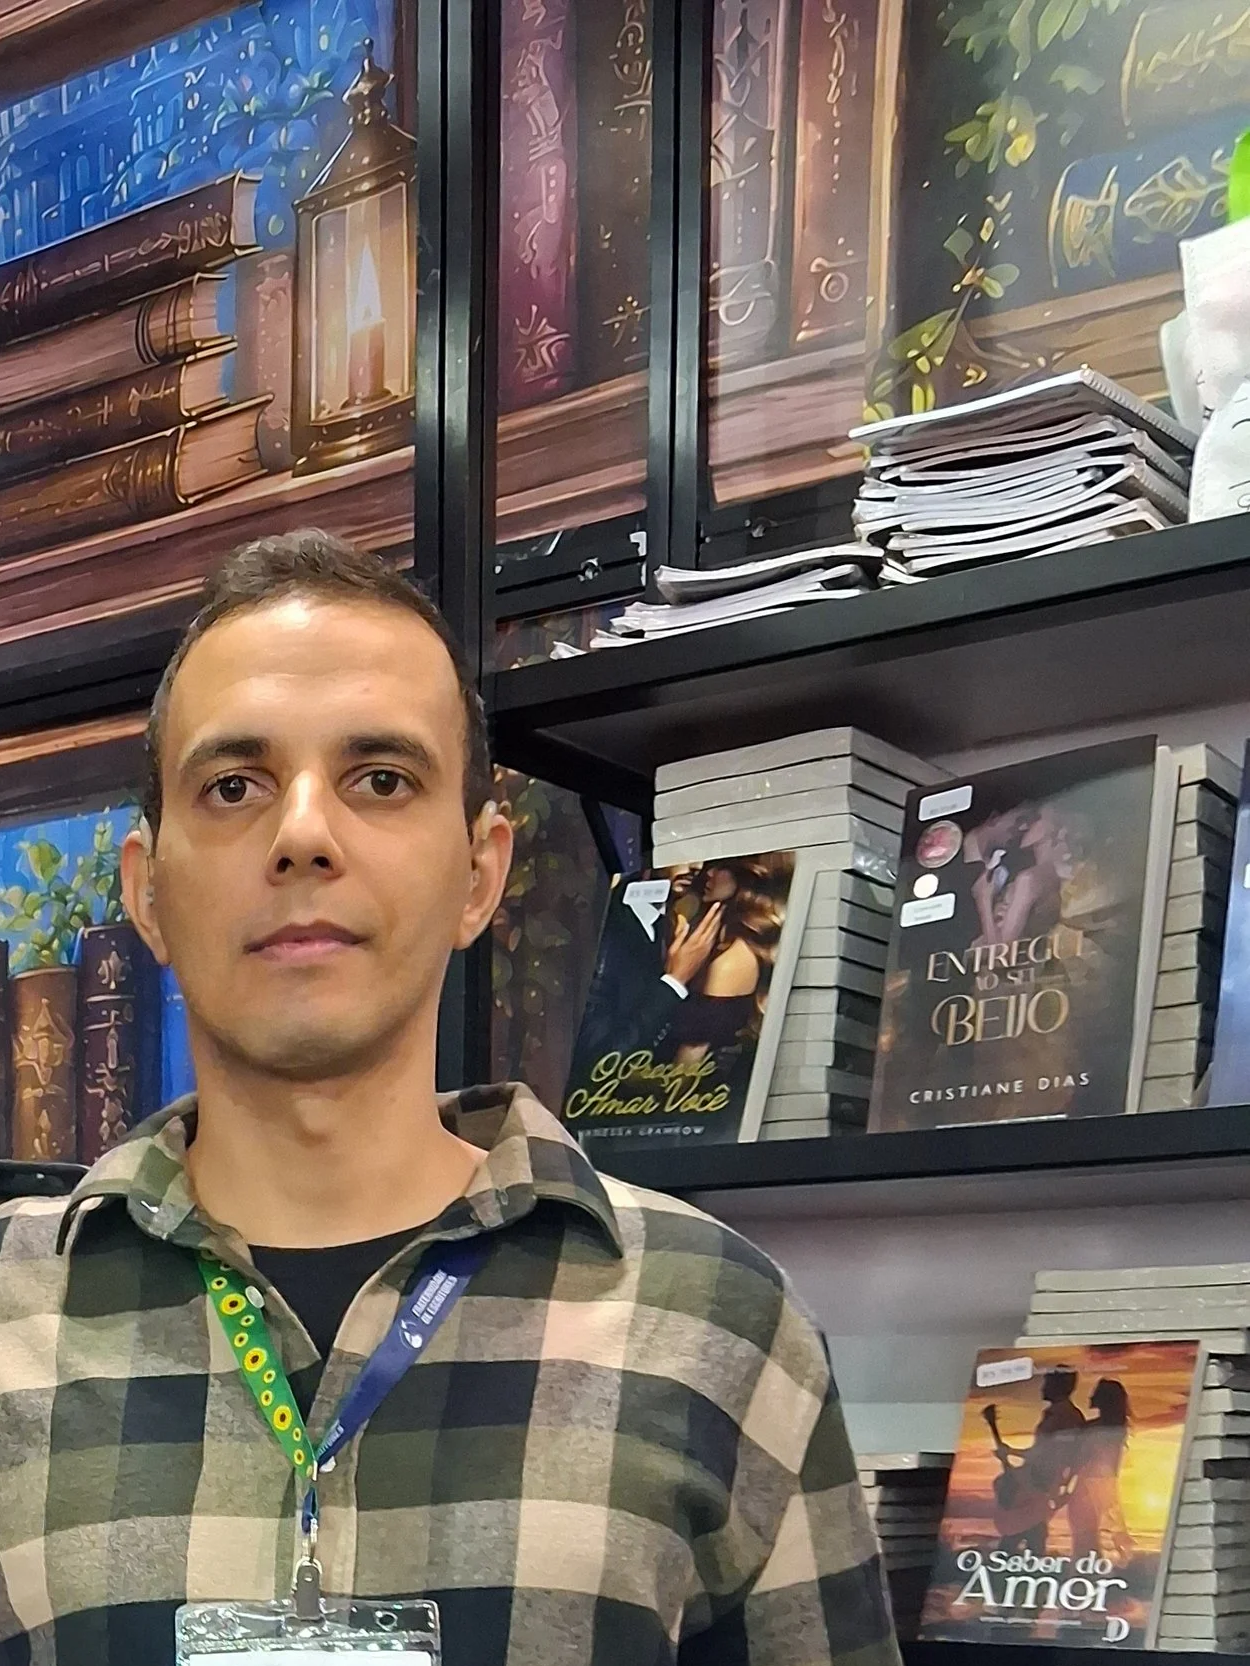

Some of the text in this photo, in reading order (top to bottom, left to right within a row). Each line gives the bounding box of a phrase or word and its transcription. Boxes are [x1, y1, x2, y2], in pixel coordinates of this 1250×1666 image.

[931, 988, 1070, 1046] BEIJO
[565, 1077, 731, 1118] Amar Você
[909, 1072, 1091, 1104] CRISTIANE DIAS
[956, 1549, 983, 1572] O
[1075, 1550, 1114, 1575] do
[952, 1565, 1129, 1612] Amor
